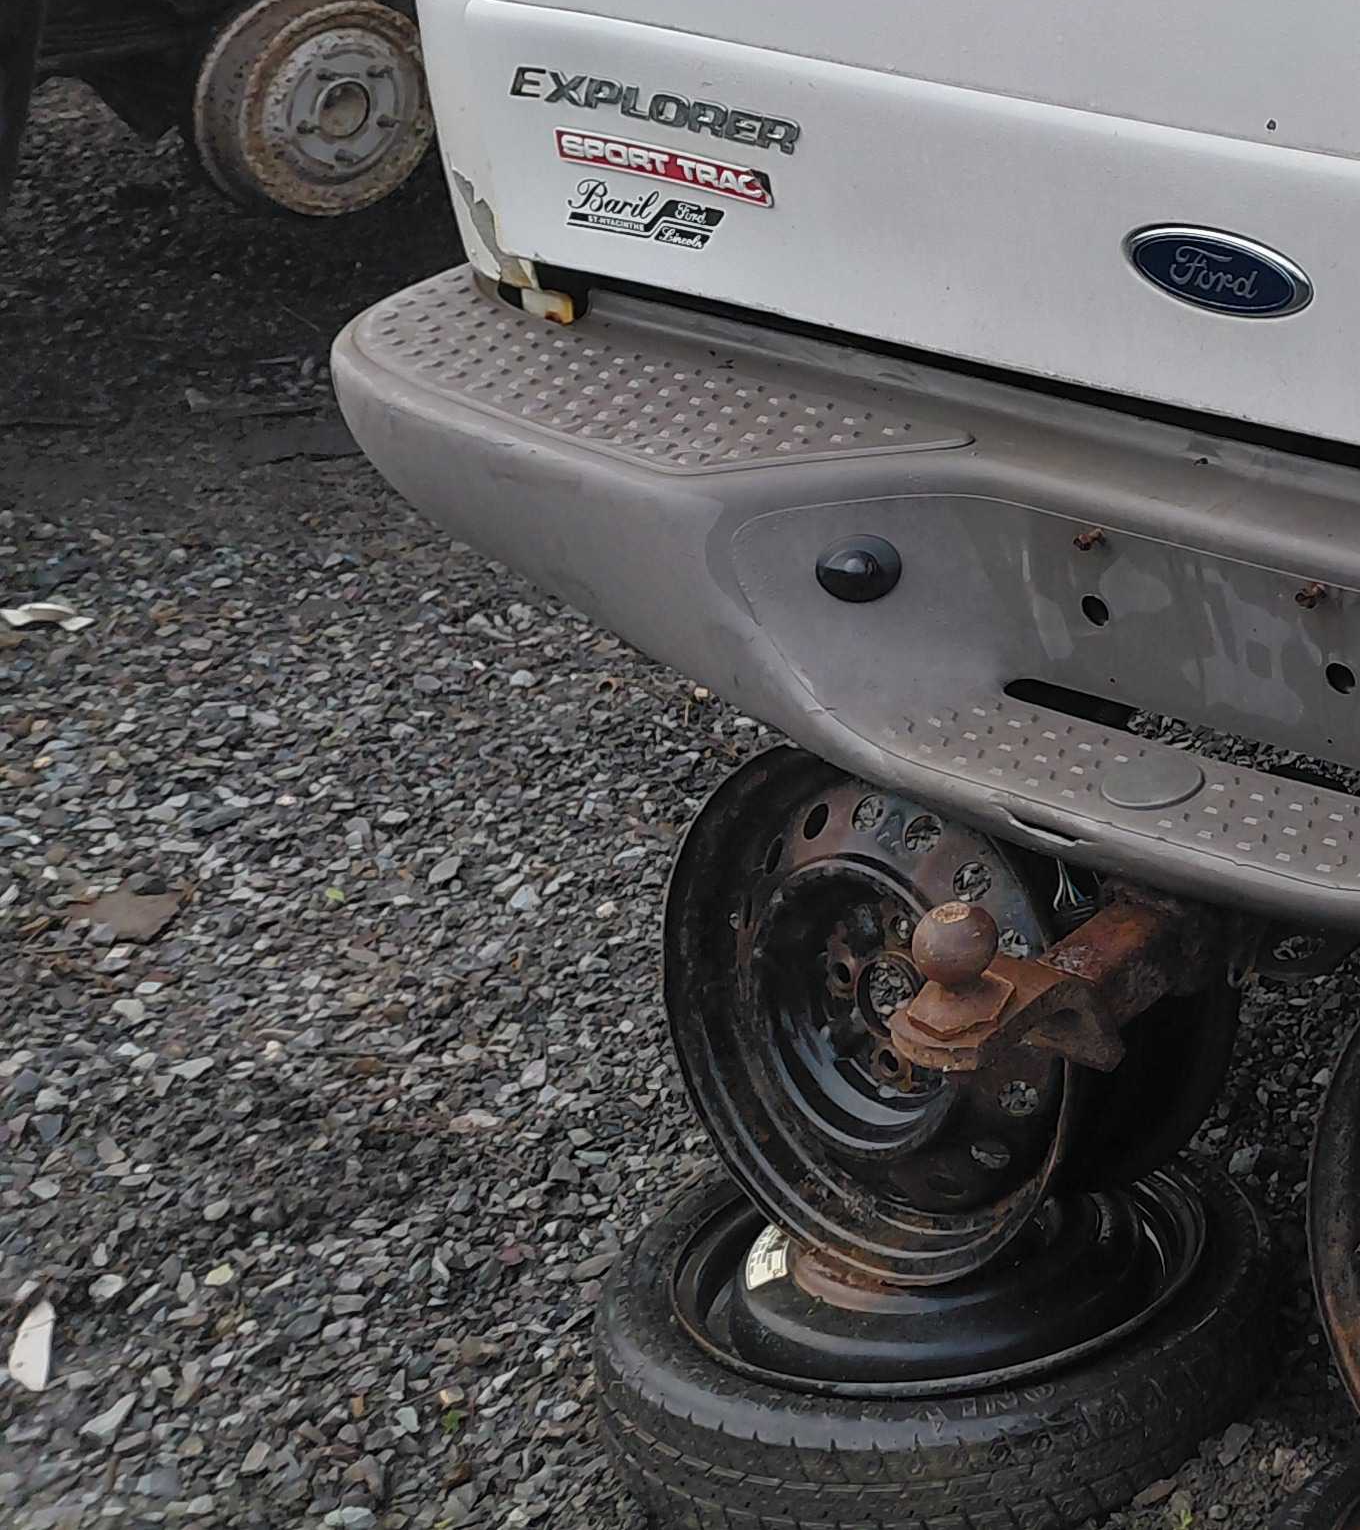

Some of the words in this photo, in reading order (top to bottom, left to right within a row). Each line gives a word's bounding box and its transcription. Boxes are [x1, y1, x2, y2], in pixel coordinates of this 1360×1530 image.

[507, 64, 801, 156] EXPLORER
[560, 134, 670, 175] SPORT
[676, 159, 764, 200] TRAC
[567, 178, 660, 220] Baril
[674, 202, 707, 224] Ford
[658, 226, 704, 249] Lincoln
[1169, 245, 1259, 300] Ford
